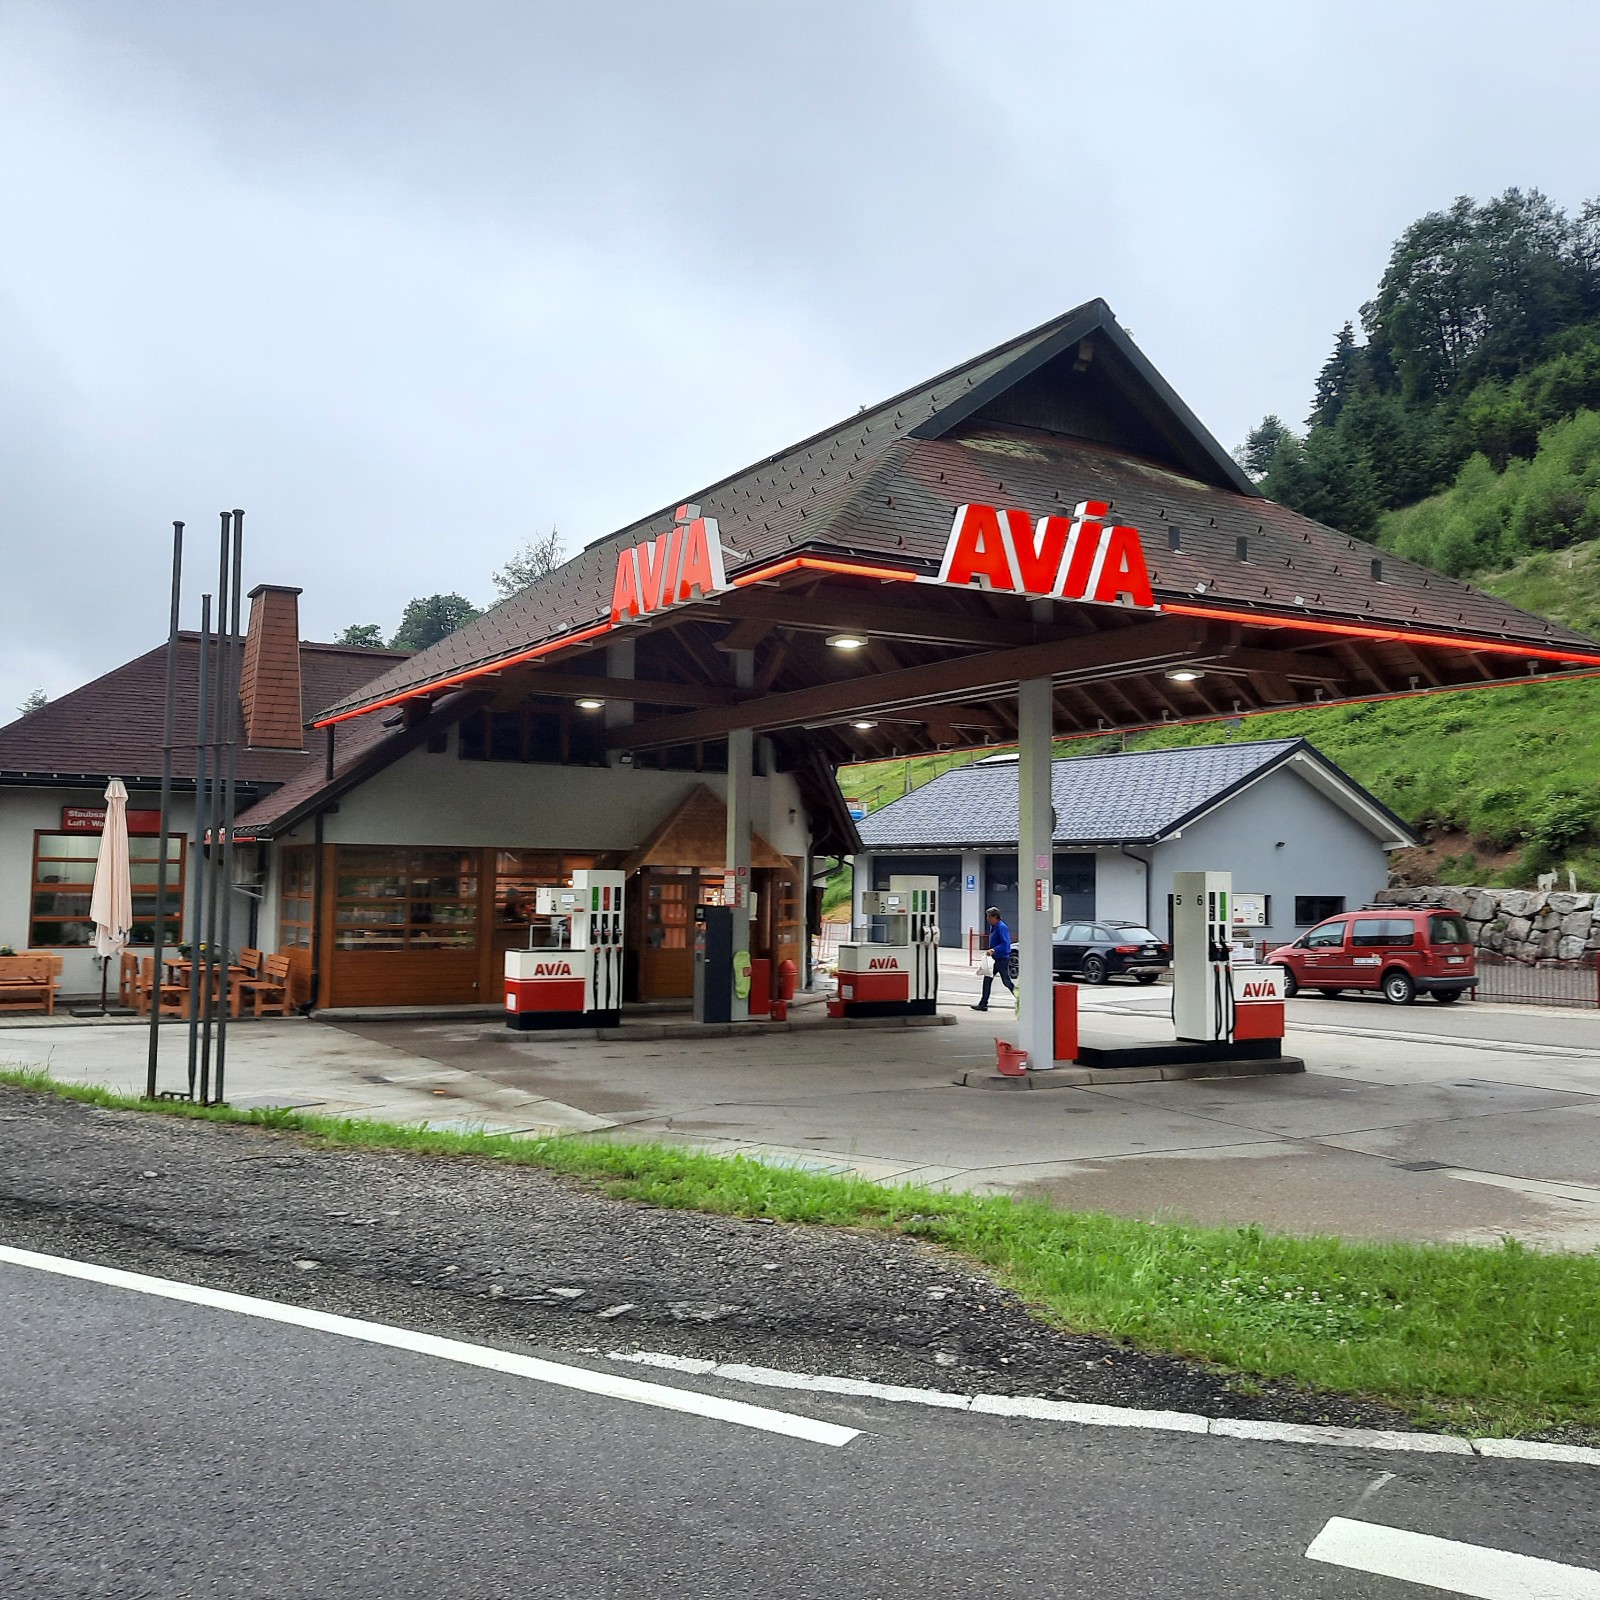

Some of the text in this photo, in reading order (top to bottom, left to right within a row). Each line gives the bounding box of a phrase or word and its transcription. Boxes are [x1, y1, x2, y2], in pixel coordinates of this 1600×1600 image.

[68, 810, 106, 818] Staubsa
[67, 819, 86, 827] Luft
[1176, 895, 1182, 905] 5
[1197, 895, 1203, 905] 6
[880, 905, 886, 914] 2
[1258, 913, 1264, 923] 6
